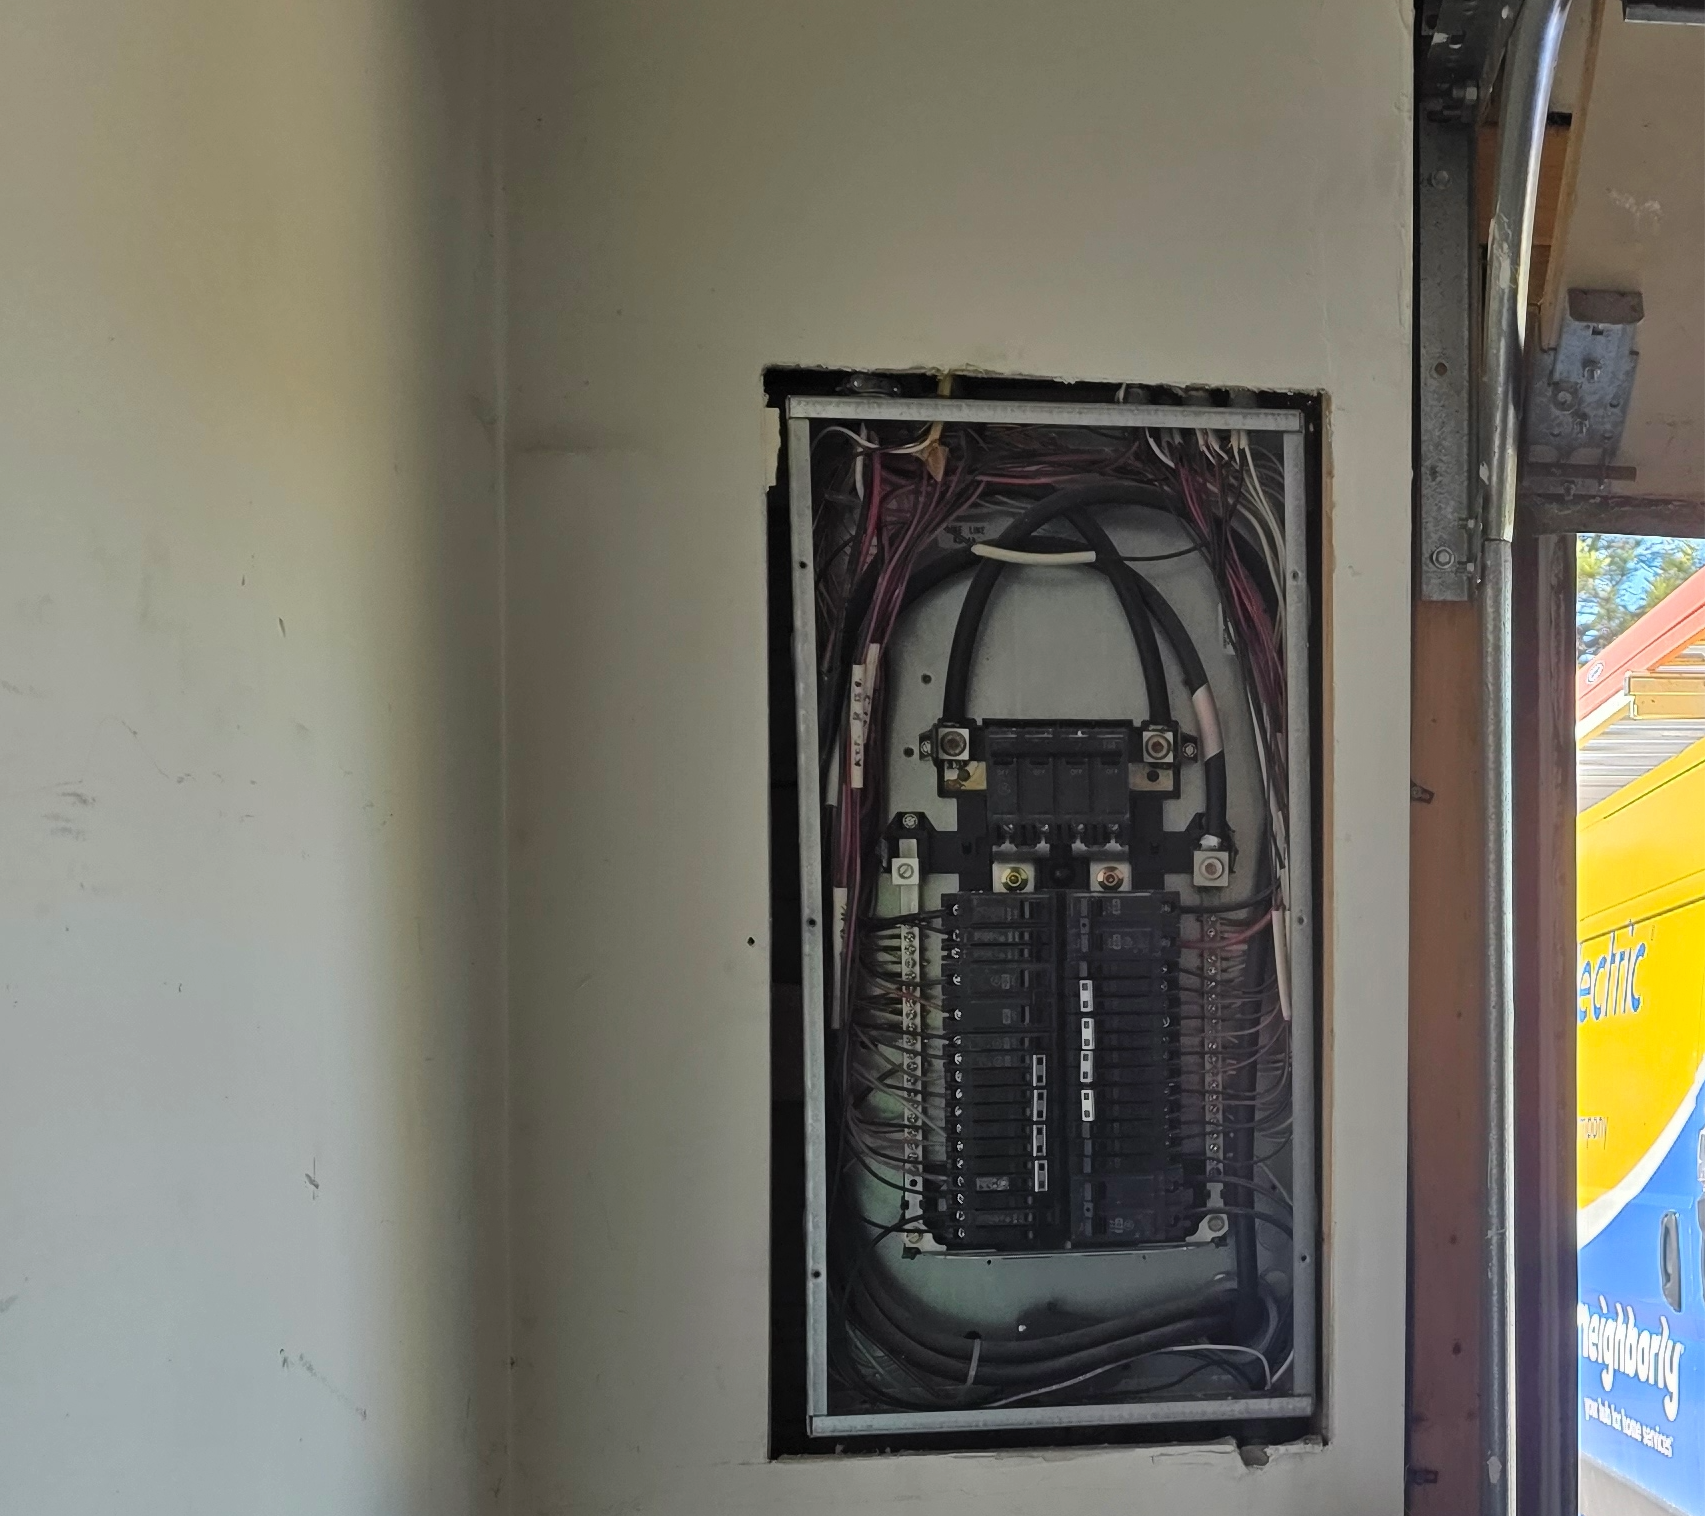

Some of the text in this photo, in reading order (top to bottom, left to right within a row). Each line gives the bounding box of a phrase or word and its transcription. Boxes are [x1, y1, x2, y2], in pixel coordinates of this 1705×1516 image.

[1577, 1295, 1683, 1422] neighborly
[1621, 1408, 1641, 1442] home
[1642, 1425, 1672, 1458] services
